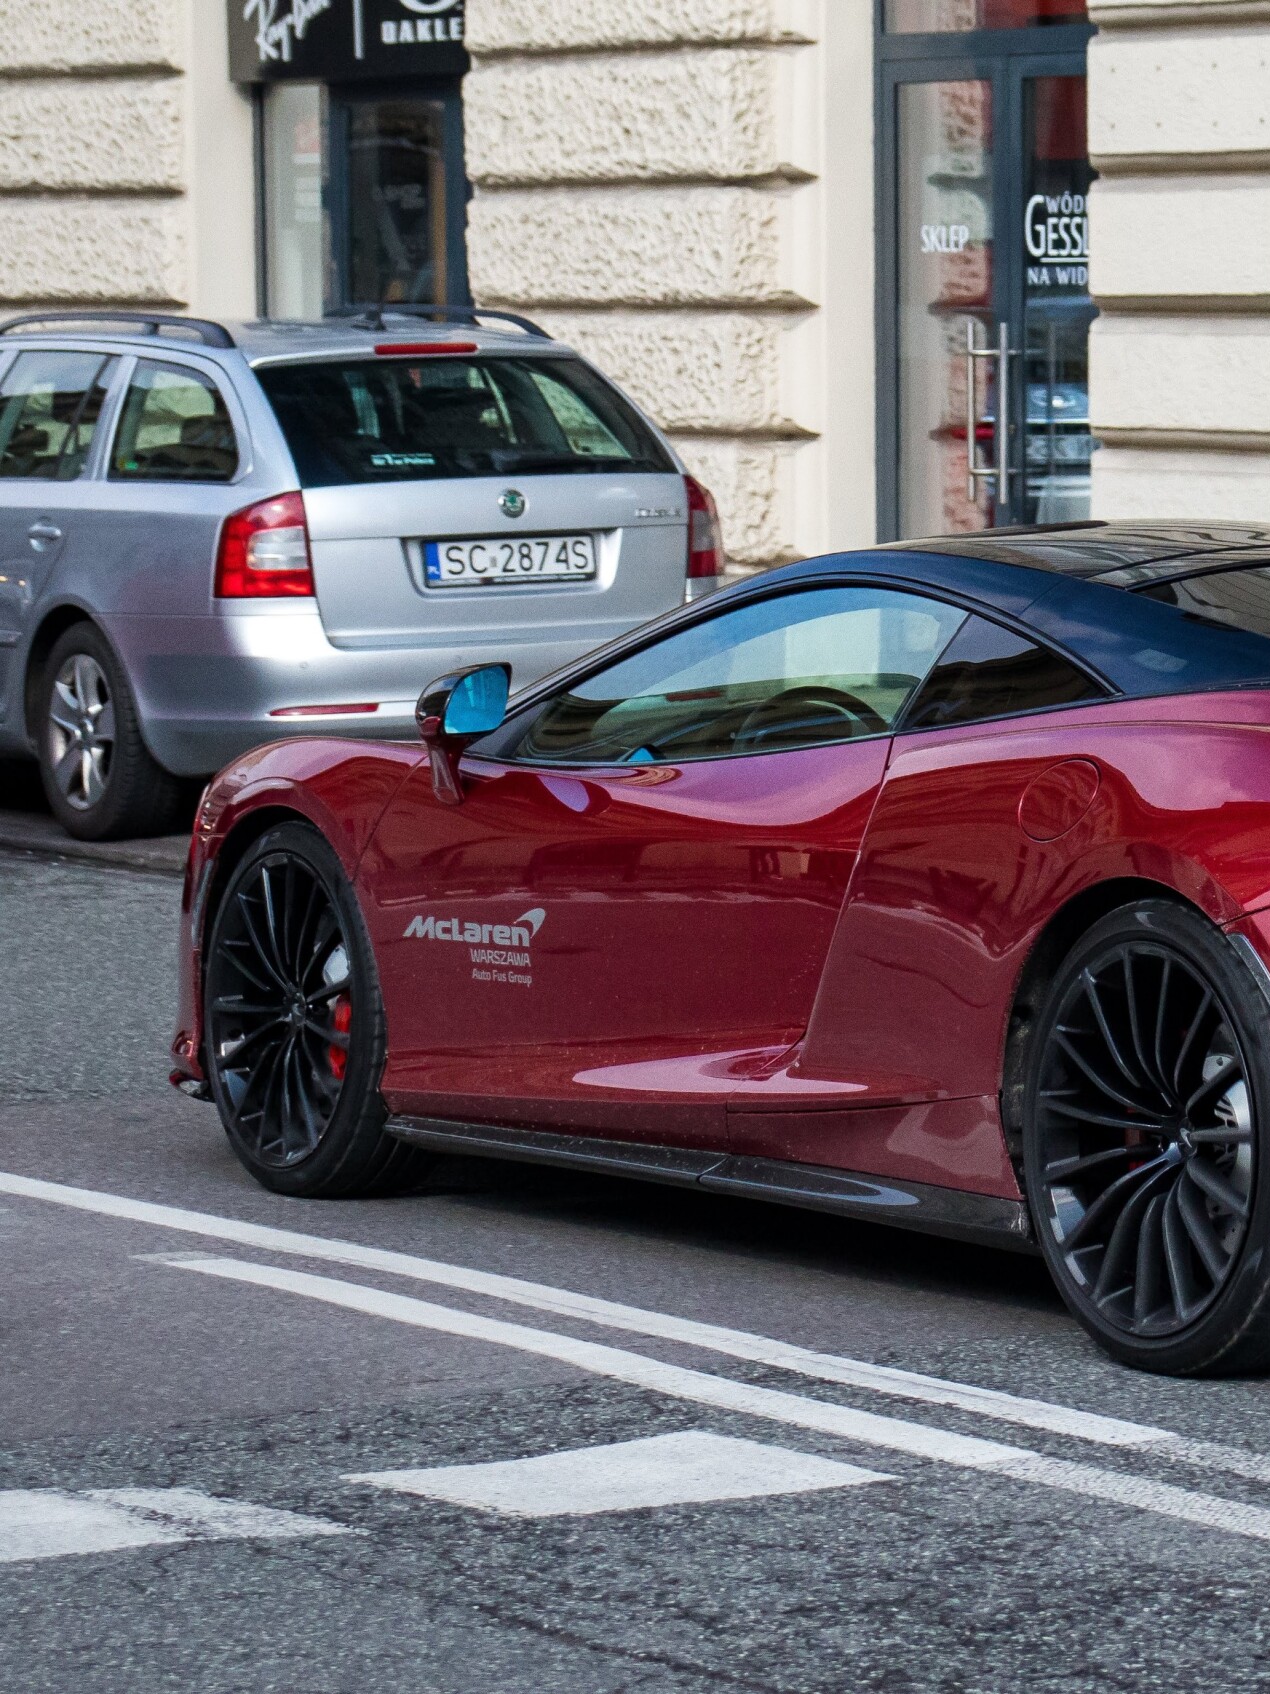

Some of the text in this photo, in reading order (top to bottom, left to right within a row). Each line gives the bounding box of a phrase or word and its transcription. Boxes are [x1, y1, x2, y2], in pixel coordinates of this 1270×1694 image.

[382, 17, 463, 44] OAKLE
[1044, 190, 1088, 215] WÓD
[920, 224, 970, 253] SKLEP
[1027, 265, 1088, 287] NA WID
[445, 539, 589, 576] SC 2874S
[402, 914, 531, 948] McLaren
[470, 948, 532, 968] WARSZAWA
[472, 968, 533, 988] Auto Fus Group
